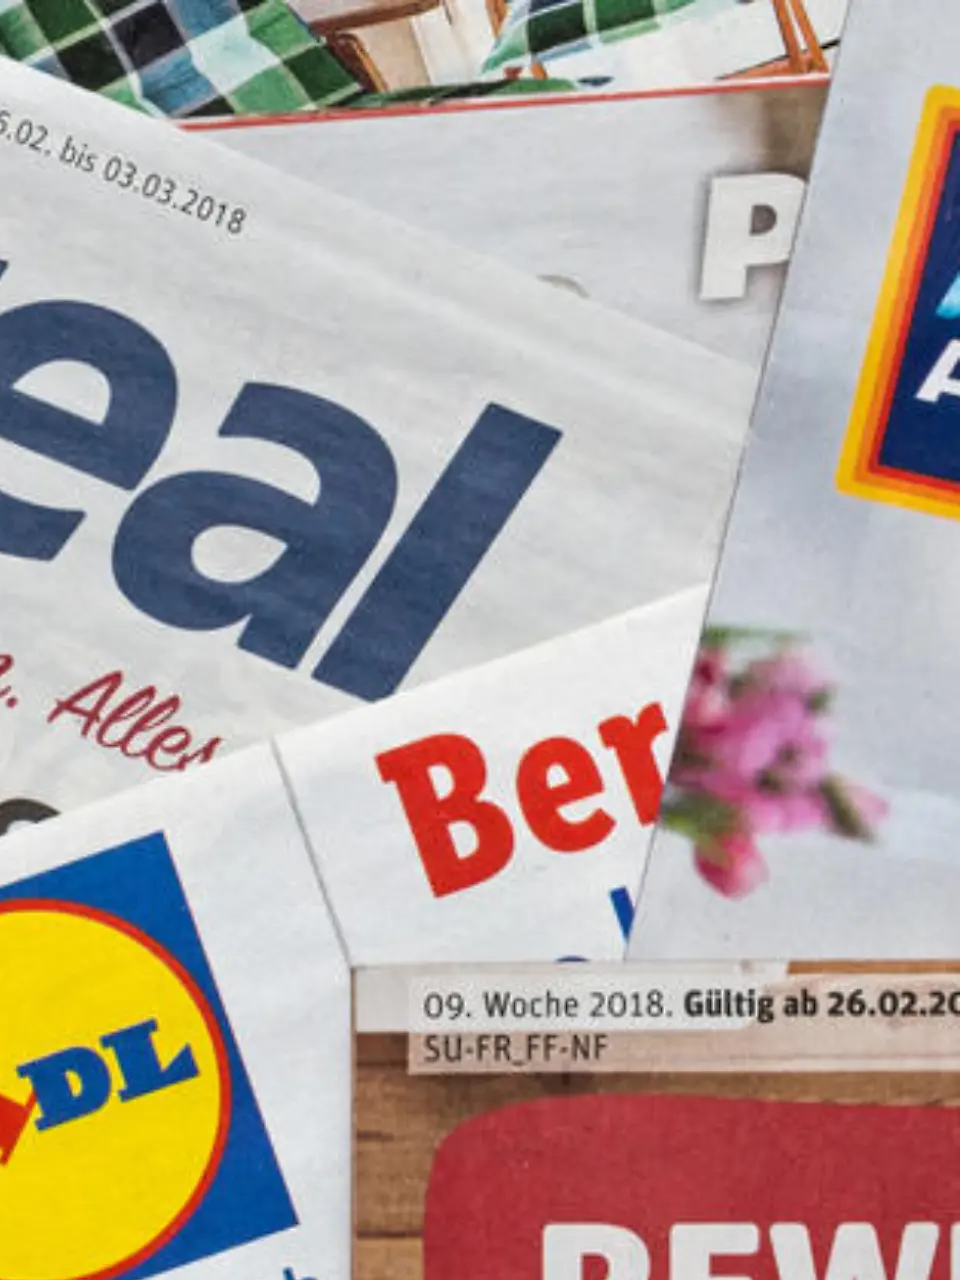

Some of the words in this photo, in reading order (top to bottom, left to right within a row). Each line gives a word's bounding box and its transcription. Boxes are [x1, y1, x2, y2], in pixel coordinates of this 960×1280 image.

[60, 136, 96, 172] bis
[103, 156, 247, 234] 03.03.2018
[424, 991, 471, 1019] 09.
[483, 990, 578, 1018] Woche
[589, 990, 673, 1018] 2018.
[684, 988, 774, 1023] Gültig
[783, 988, 819, 1017] ab
